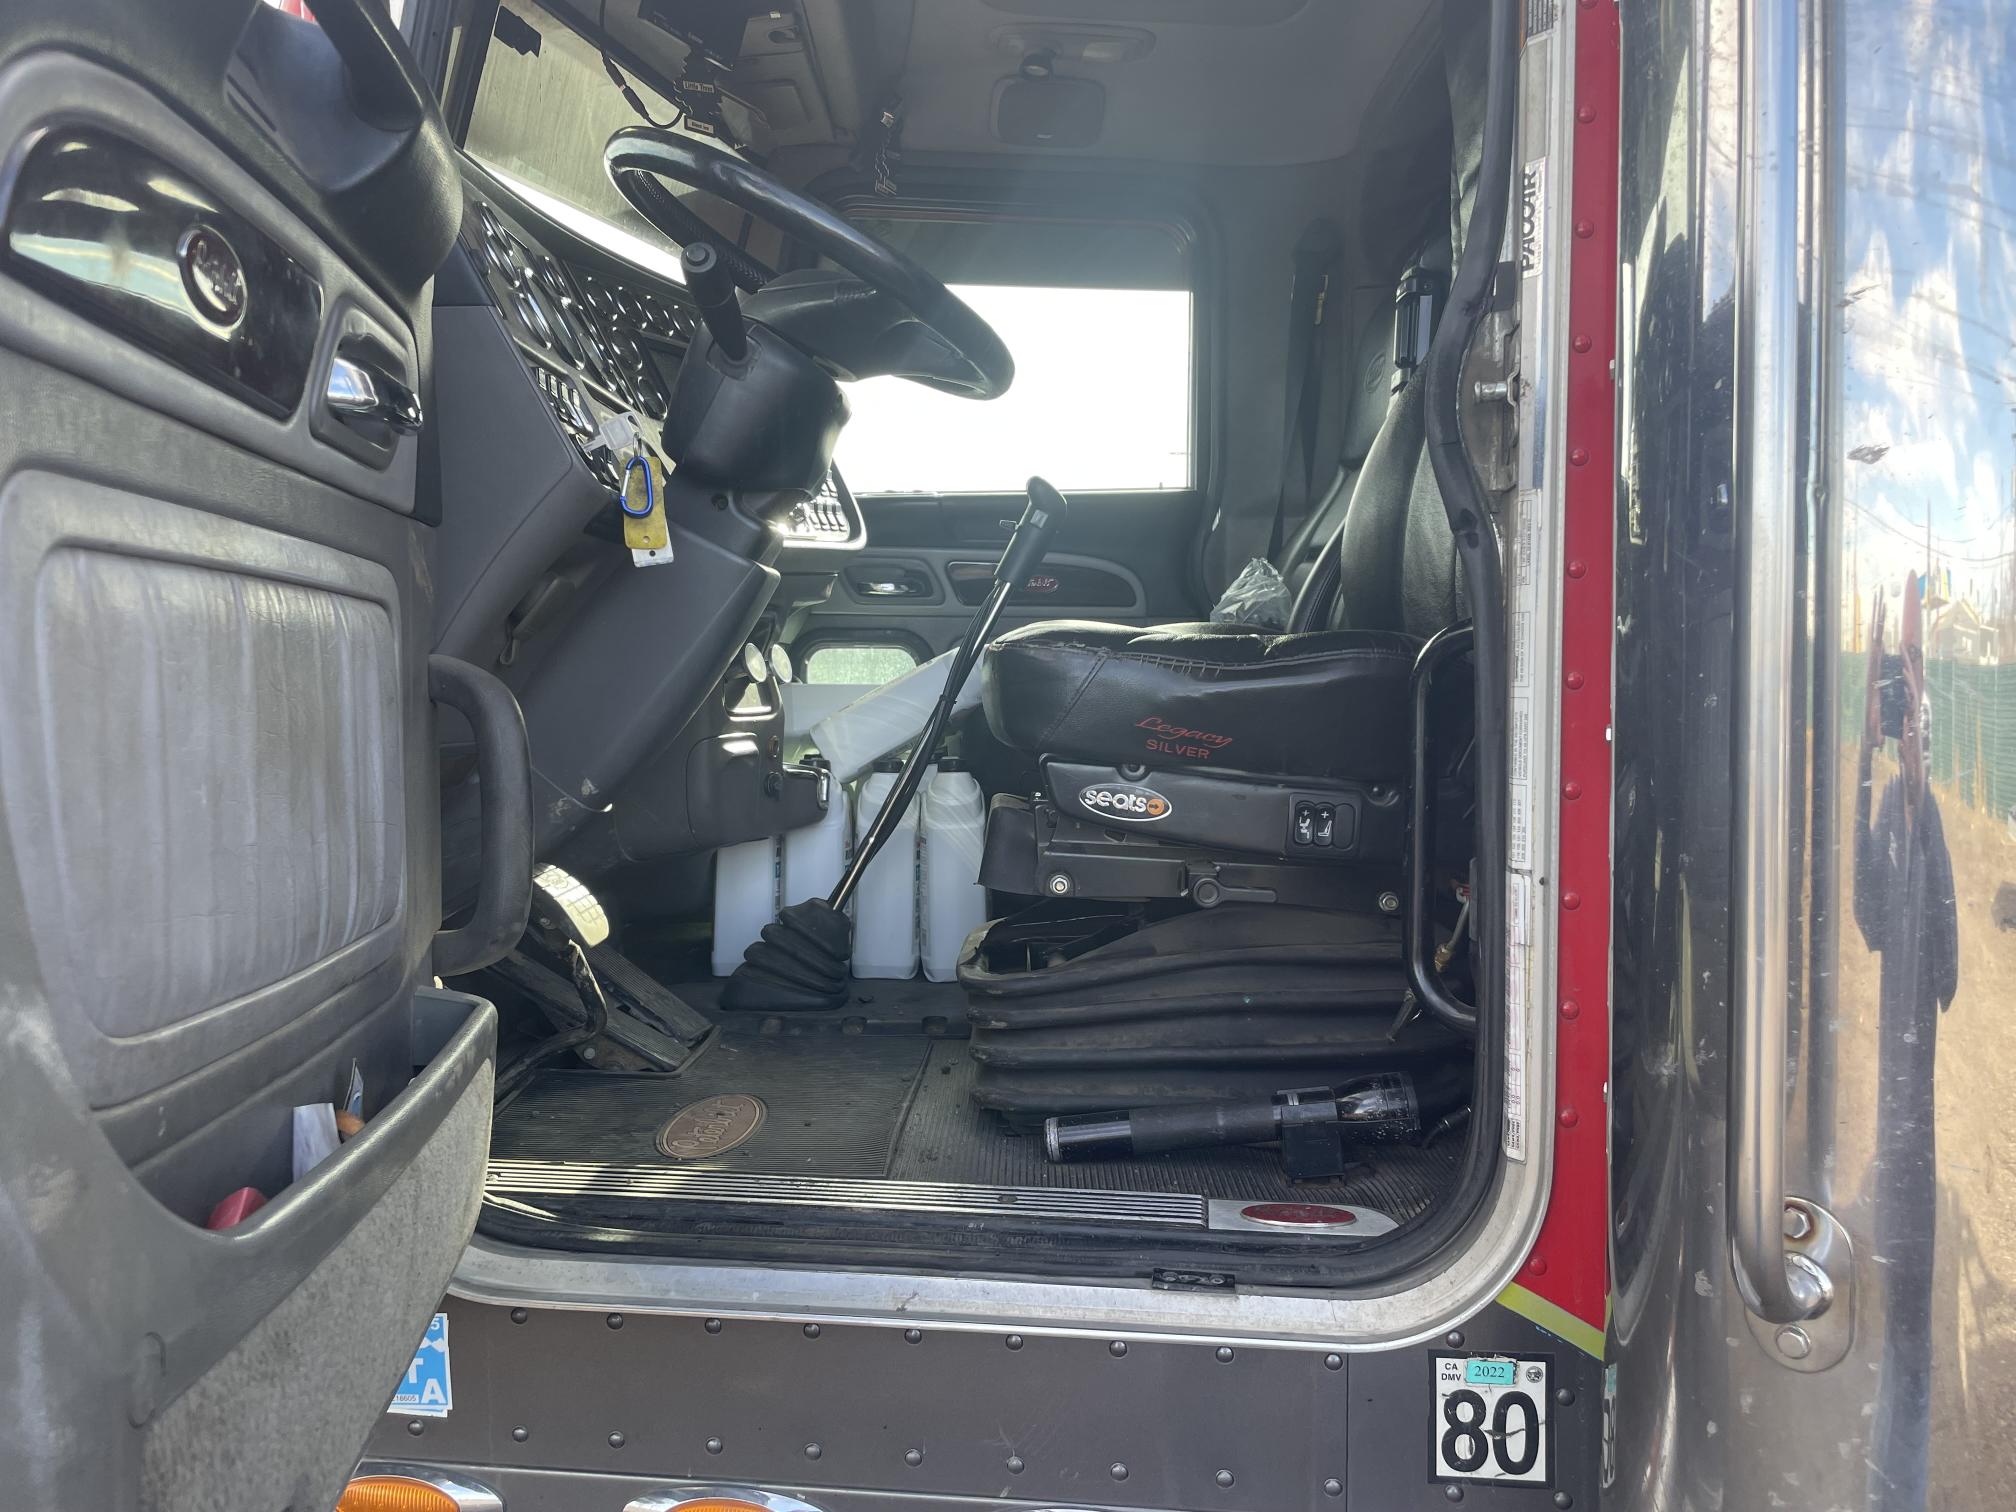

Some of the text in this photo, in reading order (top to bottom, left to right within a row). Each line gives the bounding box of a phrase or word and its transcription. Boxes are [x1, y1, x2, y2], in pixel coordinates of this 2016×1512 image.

[1521, 170, 1536, 272] PACCAR
[1135, 717, 1232, 748] Legacy
[1146, 739, 1210, 759] SILVER
[1085, 790, 1147, 812] seats
[1441, 1373, 1461, 1381] DMV
[1444, 1362, 1458, 1371] CA
[1474, 1365, 1505, 1378] 2022
[1441, 1389, 1540, 1475] 80
